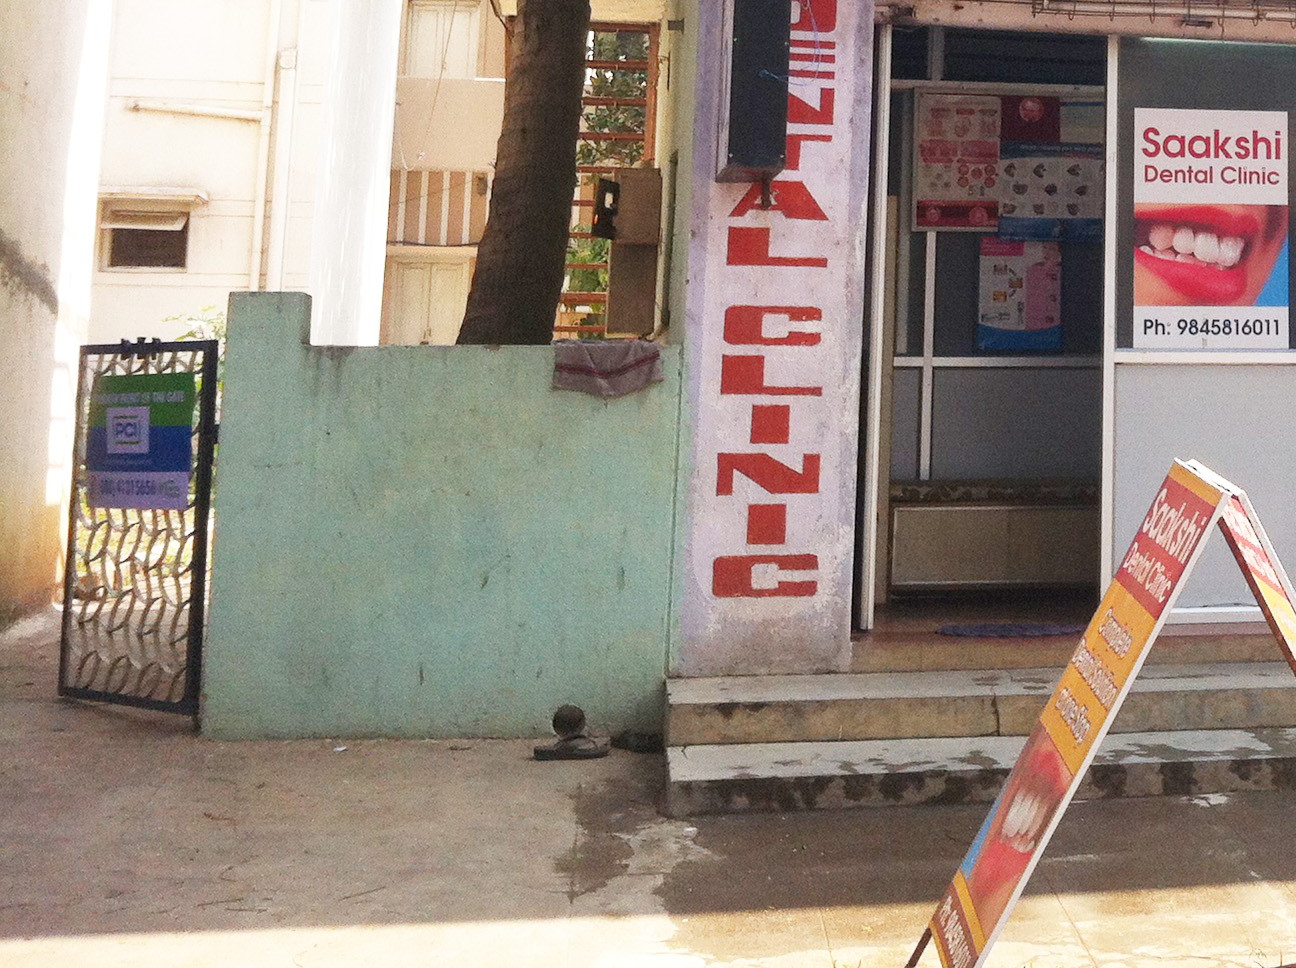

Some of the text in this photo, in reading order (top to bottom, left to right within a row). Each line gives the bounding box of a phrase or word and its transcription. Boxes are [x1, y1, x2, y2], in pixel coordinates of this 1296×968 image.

[1142, 127, 1281, 160] Saakshi
[1144, 165, 1280, 185] Dental Clinic
[1144, 318, 1280, 336] Ph: 9845816011
[711, 305, 823, 598] CLINIC
[1142, 487, 1208, 565] Saakshi
[1122, 541, 1172, 604] Dental Clinic
